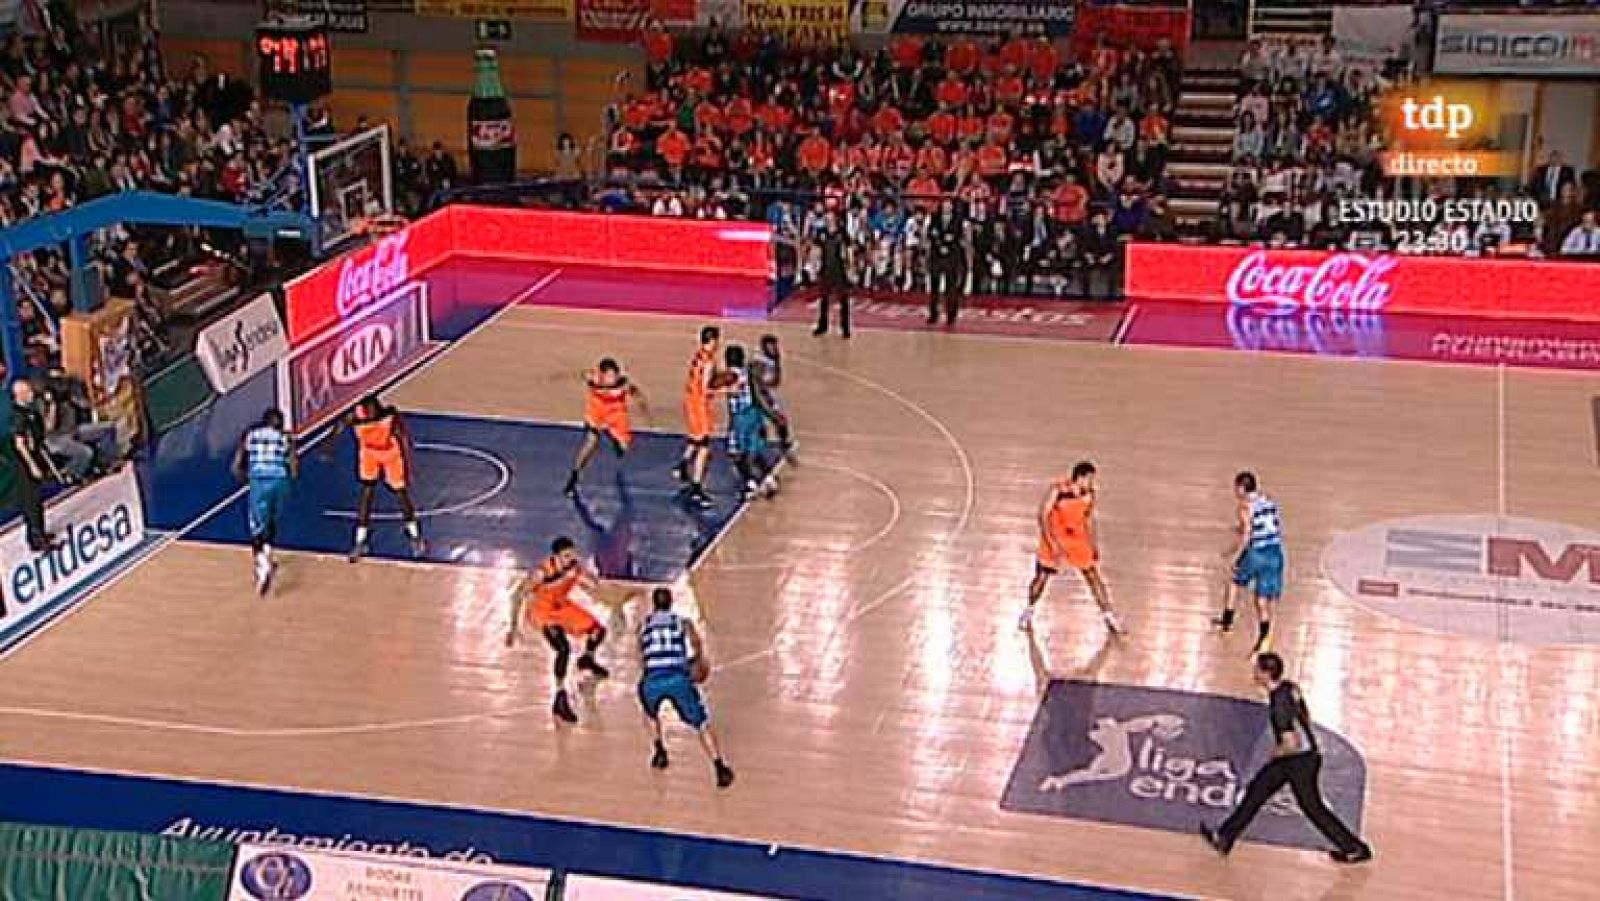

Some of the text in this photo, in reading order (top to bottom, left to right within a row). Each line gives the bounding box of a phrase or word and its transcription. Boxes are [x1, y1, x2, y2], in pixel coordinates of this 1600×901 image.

[341, 327, 386, 377] KIA
[11, 503, 132, 604] endesa
[1139, 736, 1237, 782] liga
